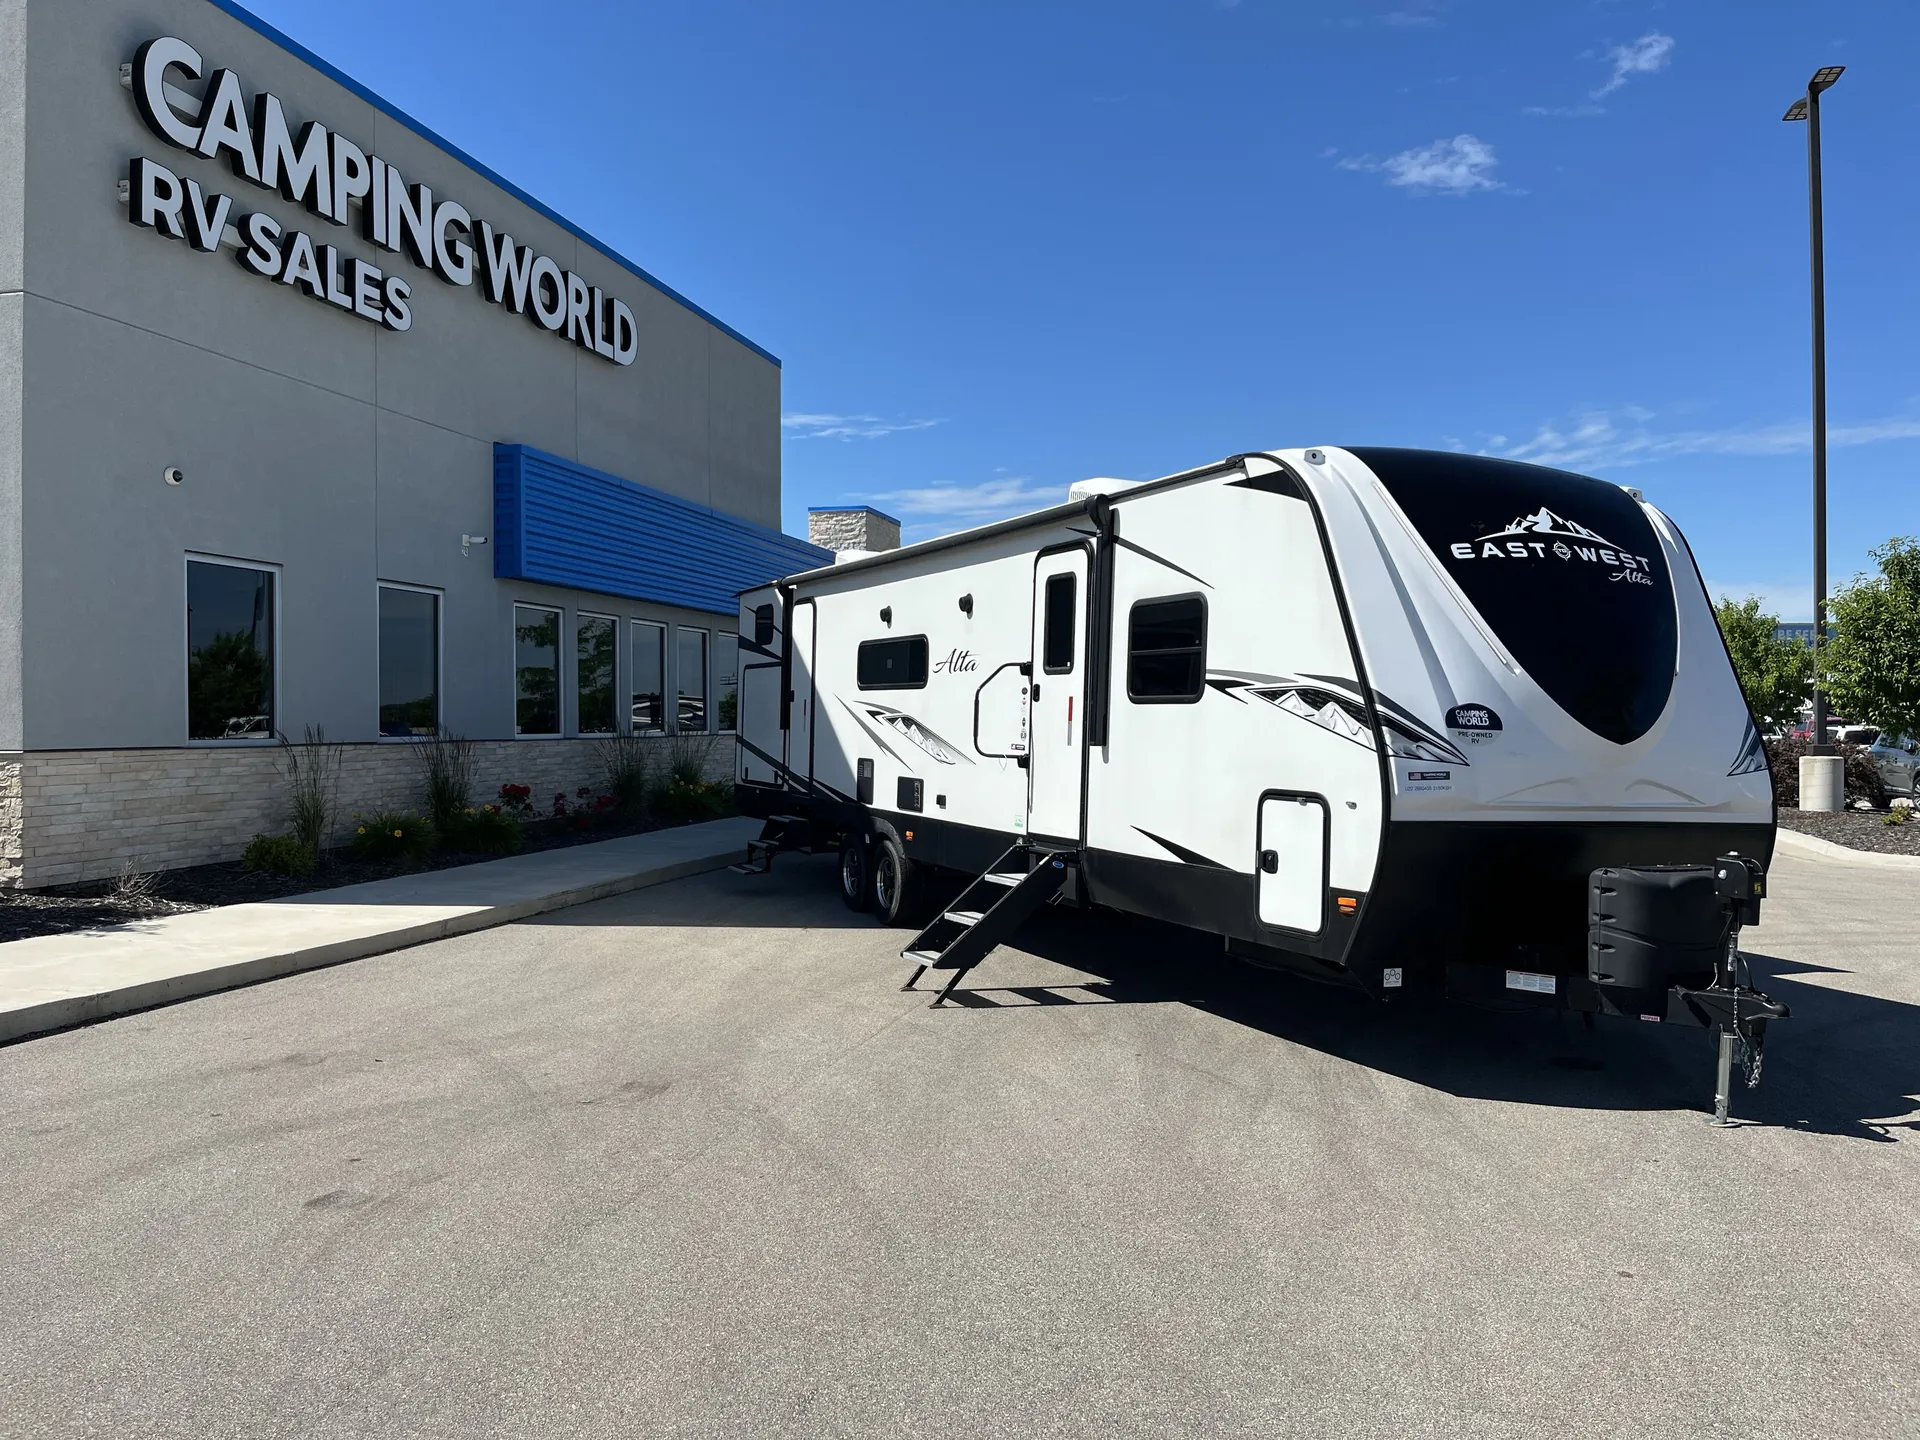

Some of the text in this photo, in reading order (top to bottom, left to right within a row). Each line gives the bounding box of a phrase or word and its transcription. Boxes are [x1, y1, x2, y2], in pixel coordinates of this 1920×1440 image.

[133, 36, 639, 367] CAMPING WORLD
[130, 156, 413, 332] RV SALES
[1450, 542, 1545, 559] EAST
[1573, 545, 1650, 572] WEST
[1608, 568, 1654, 586] Alta
[932, 648, 980, 675] Alta
[1455, 710, 1488, 718] CAMPING
[1457, 717, 1490, 726] WORLD
[1458, 731, 1493, 739] PRE-OWNED
